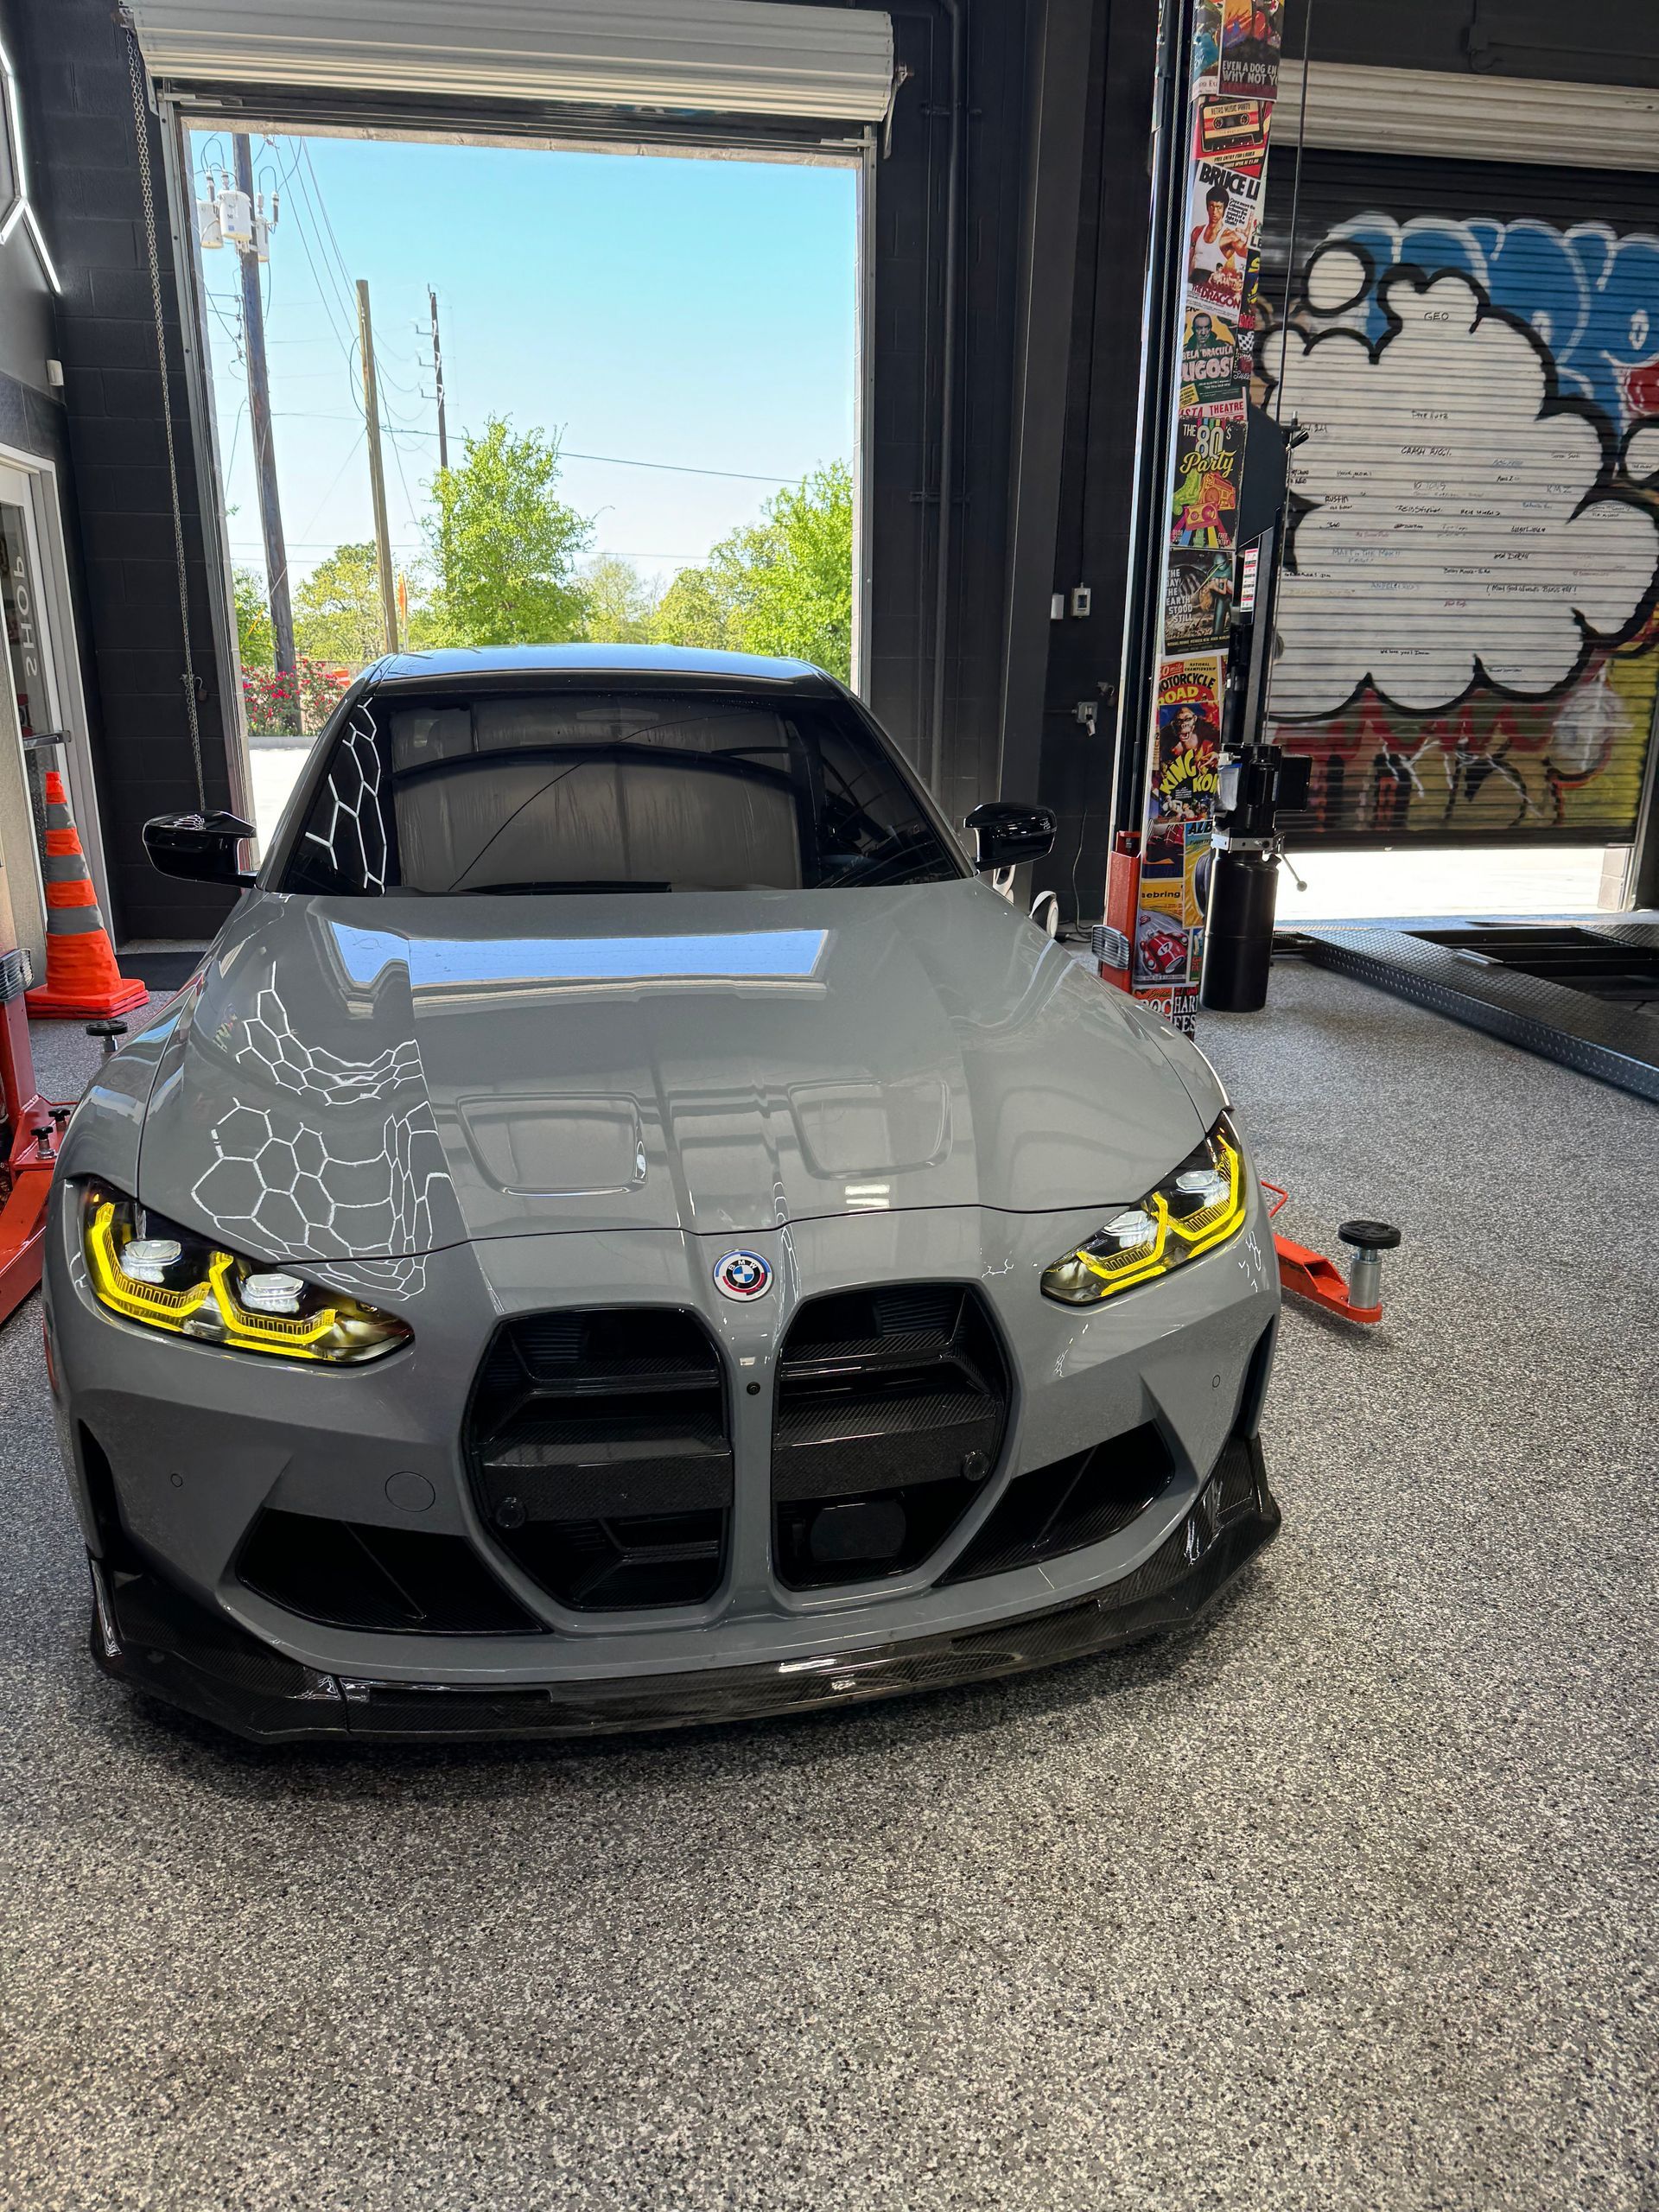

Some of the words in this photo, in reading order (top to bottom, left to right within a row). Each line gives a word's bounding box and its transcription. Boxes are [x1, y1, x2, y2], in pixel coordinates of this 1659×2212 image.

[1223, 60, 1242, 71] EVEN
[1250, 63, 1265, 73] DOG
[1223, 70, 1244, 82] WHY
[1248, 73, 1267, 85] NOT
[1199, 162, 1247, 196] BRUCE
[1200, 288, 1241, 310] DRAGON
[1424, 312, 1449, 322] GEO
[1210, 401, 1243, 416] THEATRE
[1183, 424, 1197, 436] THE
[1179, 449, 1236, 478] Party
[1166, 596, 1191, 606] EARTH
[1169, 605, 1192, 614] STOOD
[1174, 613, 1192, 622] STILL
[1160, 748, 1197, 795] KING
[1193, 773, 1219, 793] KON
[1160, 943, 1170, 954] 17
[728, 1260, 758, 1271] BMW
